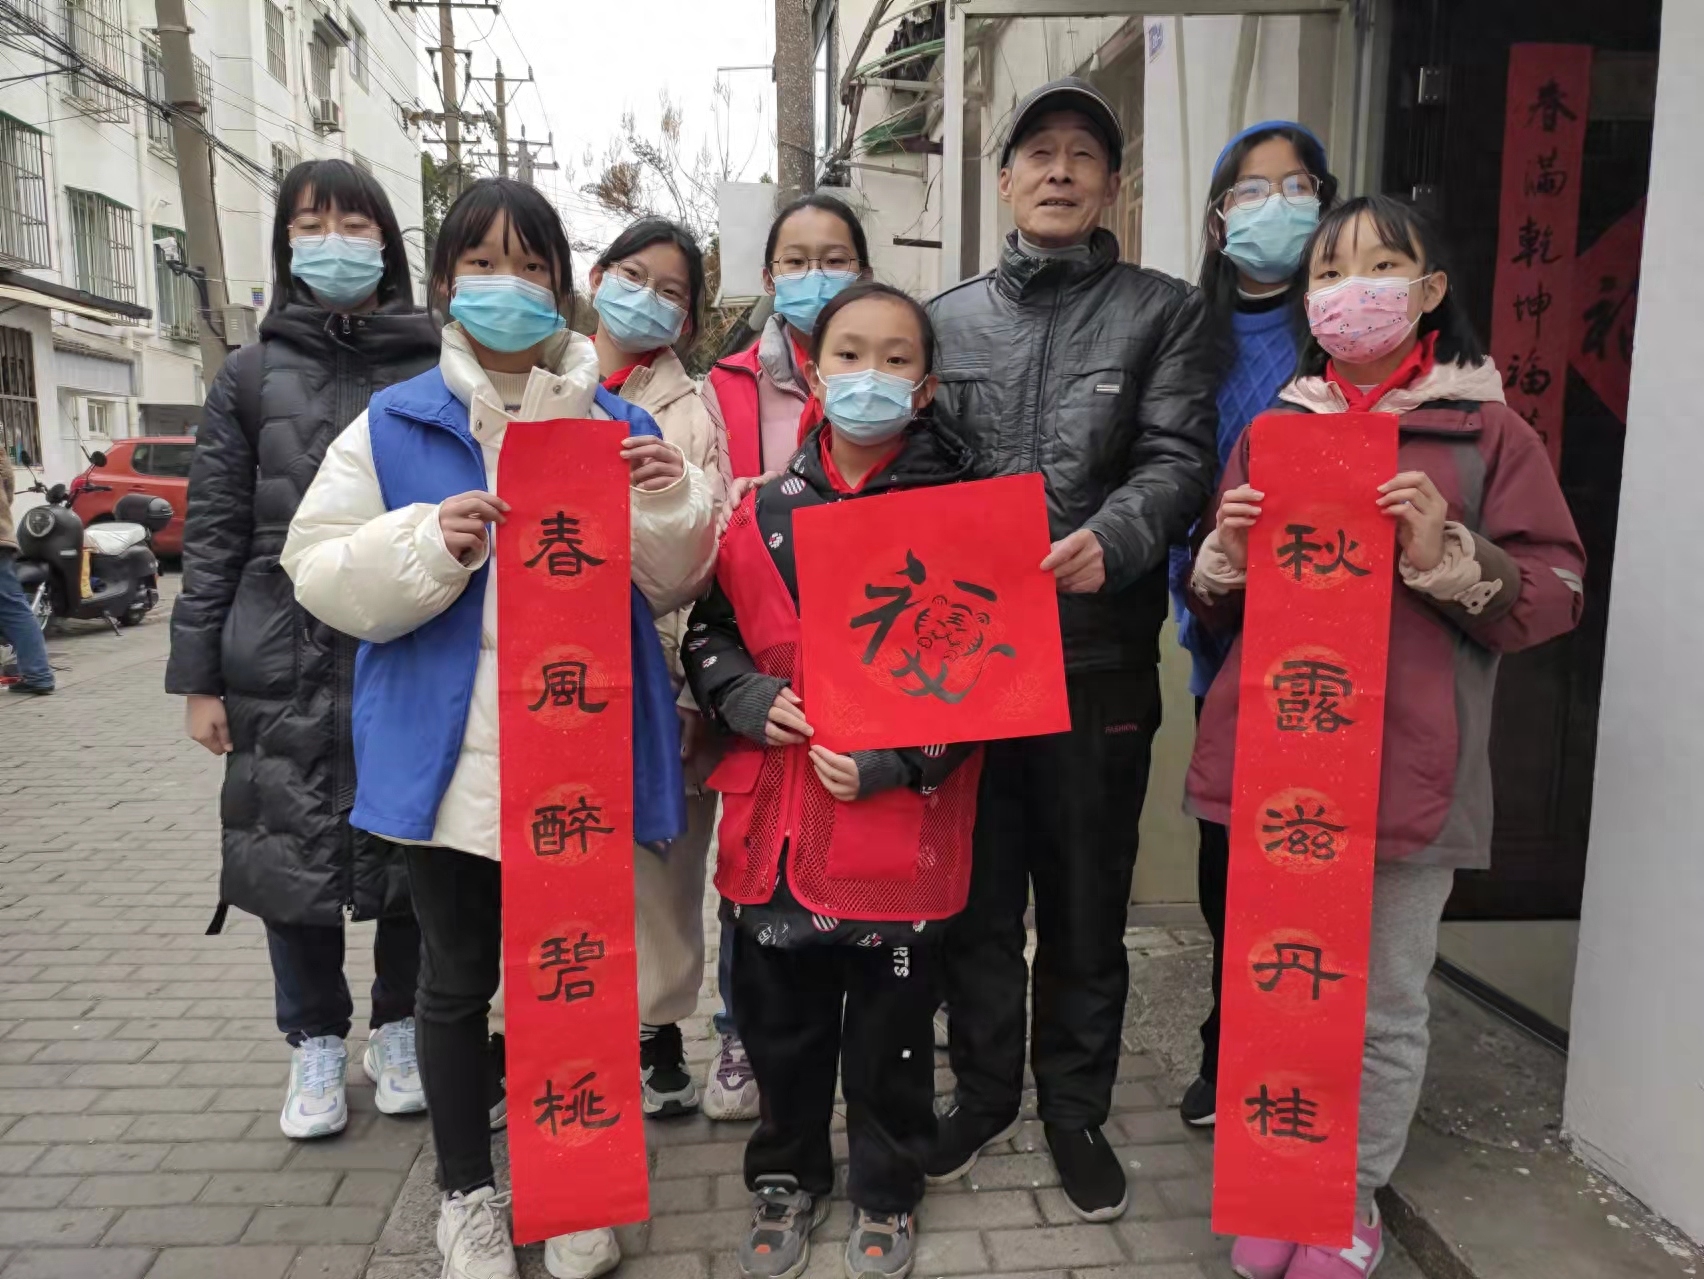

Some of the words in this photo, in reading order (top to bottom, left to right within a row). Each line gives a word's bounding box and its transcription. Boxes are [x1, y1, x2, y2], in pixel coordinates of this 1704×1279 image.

[523, 510, 620, 1136] 春風醉碧桃
[1244, 523, 1372, 1143] 秋露滋丹桂
